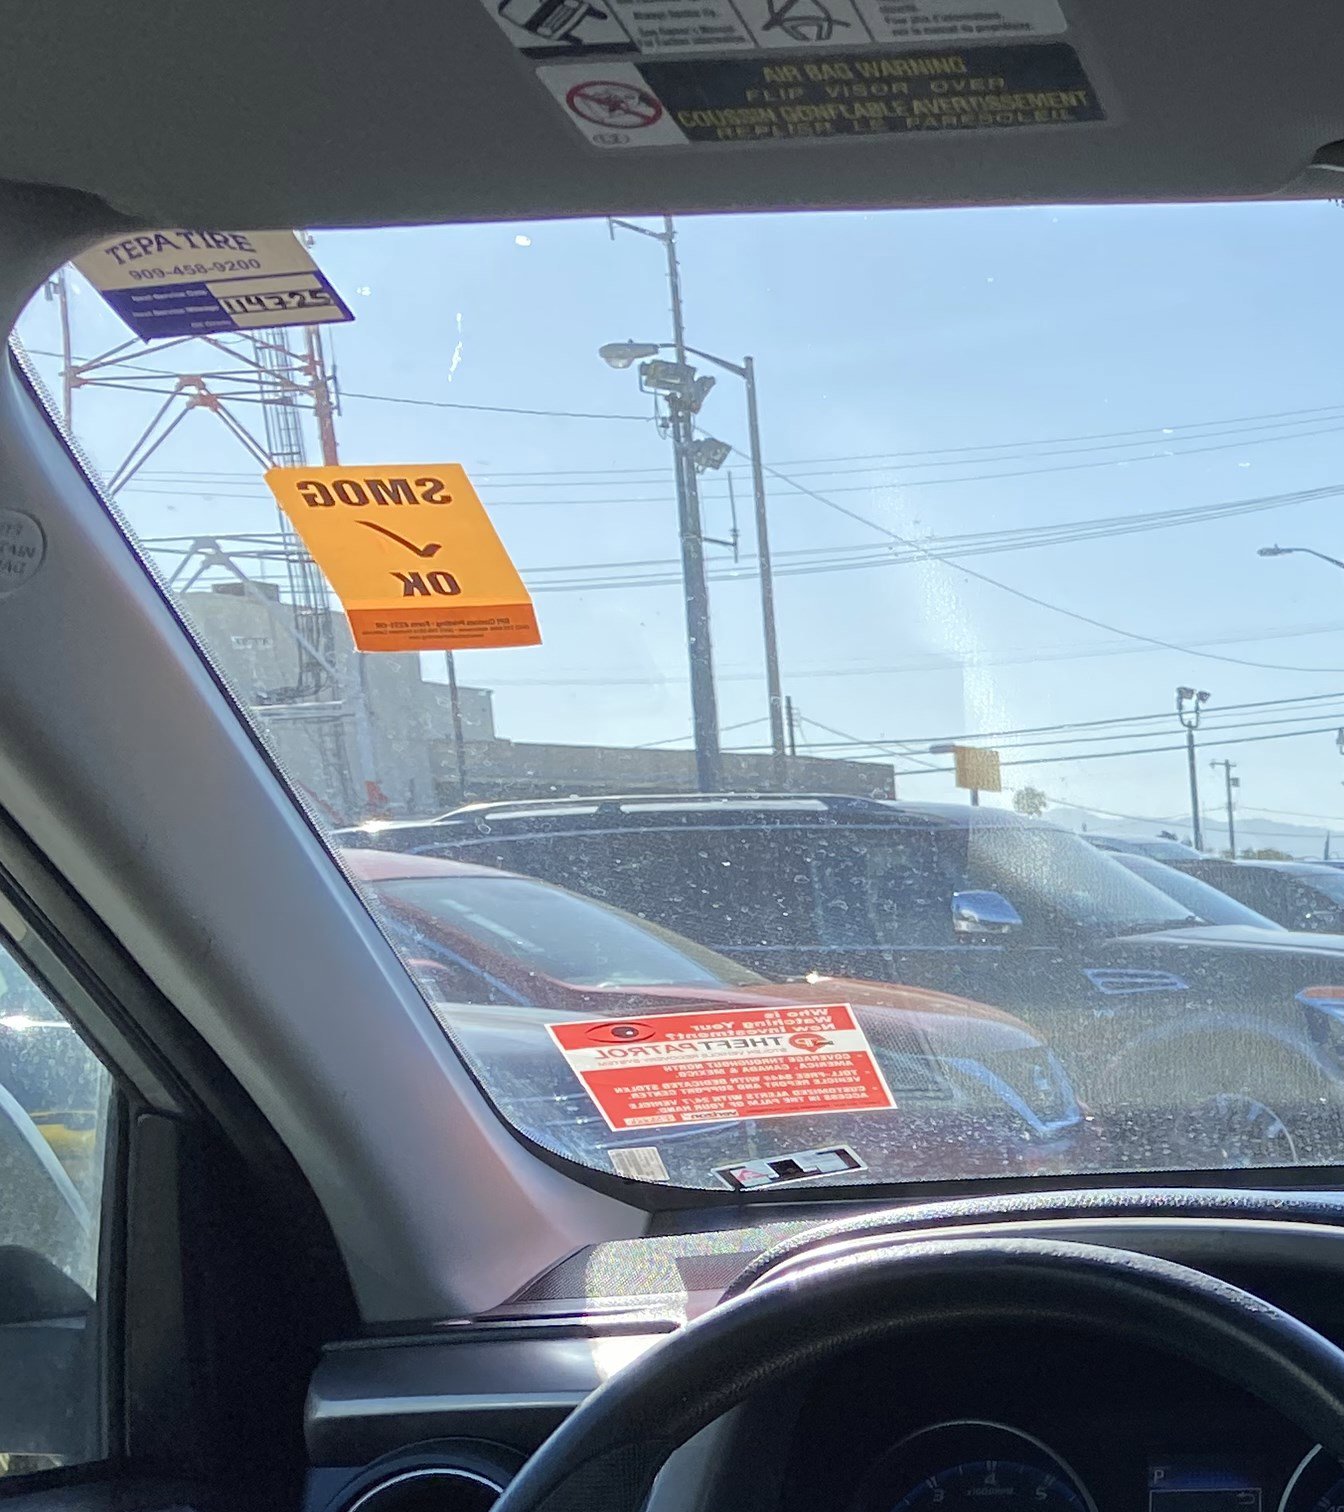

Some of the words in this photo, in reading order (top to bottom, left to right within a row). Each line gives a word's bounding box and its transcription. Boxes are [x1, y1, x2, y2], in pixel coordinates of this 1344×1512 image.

[762, 64, 802, 82] AIR
[803, 60, 855, 81] BAG
[855, 53, 967, 78] WARNING
[745, 87, 803, 103] FLIP
[825, 81, 909, 98] VISOR
[931, 76, 1005, 94] OVER
[106, 231, 180, 264] TEPA
[176, 229, 257, 253] TIRE
[984, 1472, 997, 1485] 4
[1153, 1468, 1165, 1482] P
[933, 1488, 945, 1502] 3
[1035, 1487, 1048, 1501] 5
